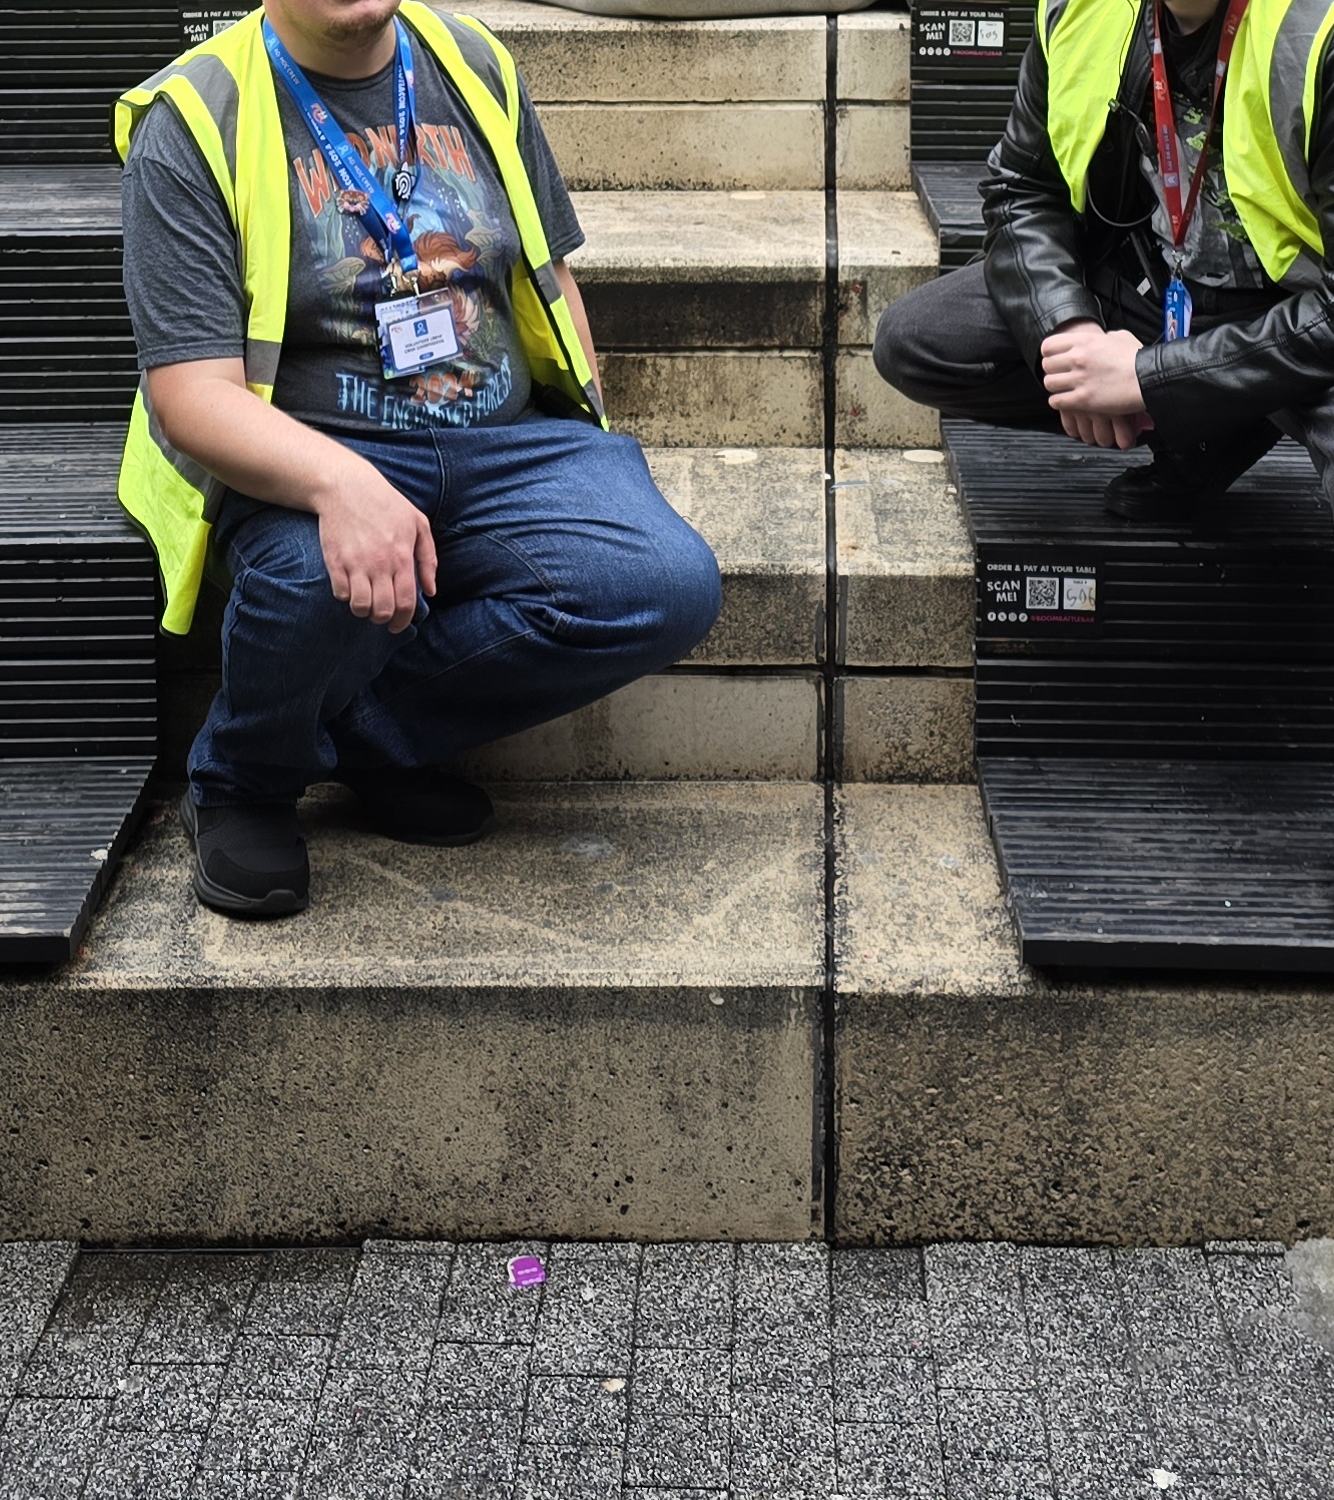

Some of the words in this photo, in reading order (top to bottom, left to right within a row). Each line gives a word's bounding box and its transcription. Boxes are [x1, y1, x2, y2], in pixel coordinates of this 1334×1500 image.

[183, 24, 209, 34] SCAN
[919, 22, 946, 32] SCAN
[364, 123, 476, 182] NRTH
[335, 372, 379, 420] THE
[987, 580, 1021, 592] SCAN
[996, 592, 1017, 602] ME!
